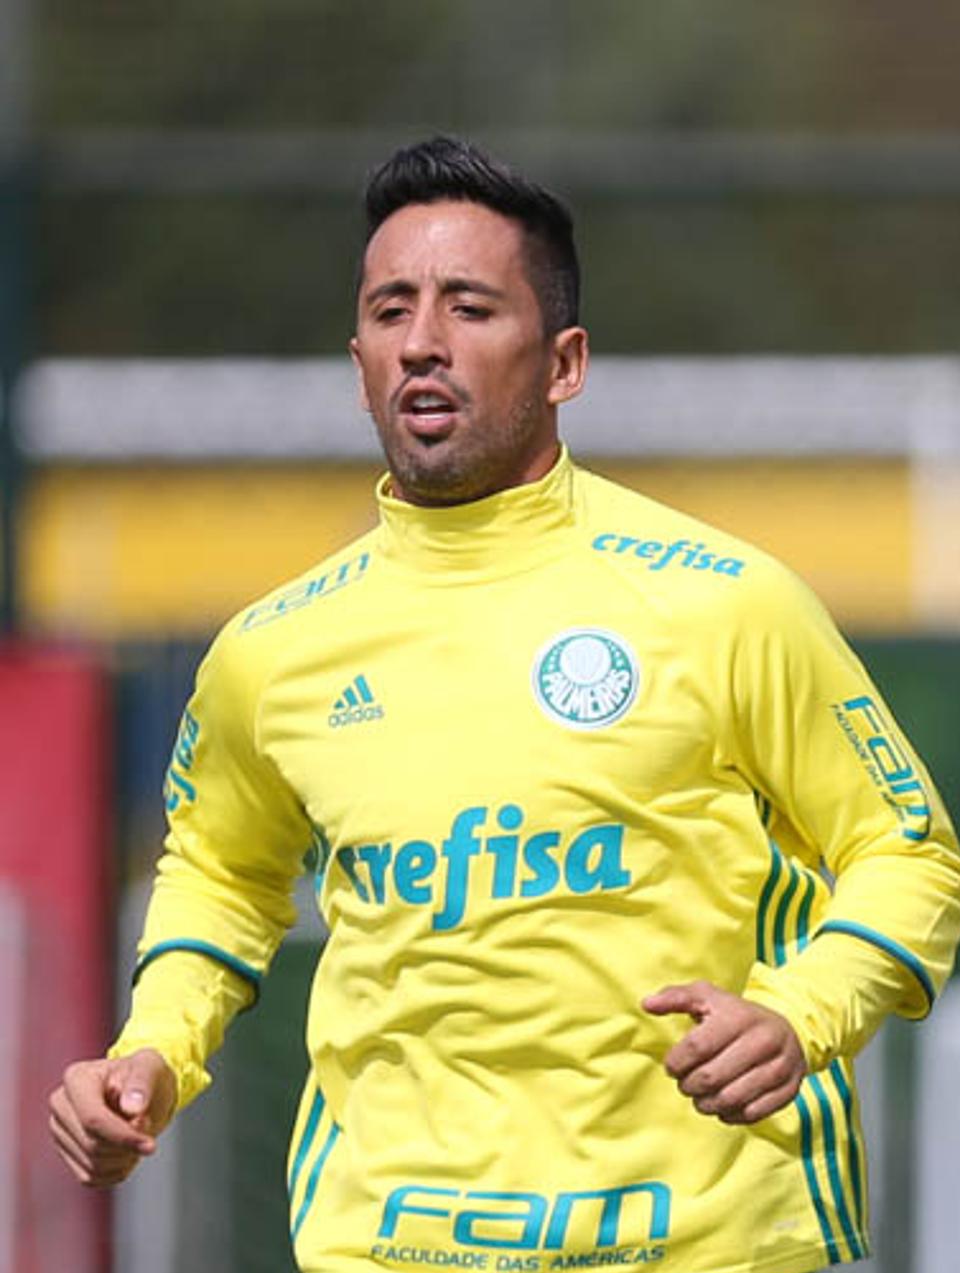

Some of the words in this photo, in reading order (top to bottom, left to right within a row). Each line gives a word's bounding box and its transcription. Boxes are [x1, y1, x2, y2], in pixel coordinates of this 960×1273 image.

[592, 533, 745, 577] crefisa
[541, 668, 632, 720] PALMEIRAS
[328, 702, 385, 728] adidas
[370, 1243, 489, 1270] FACULDADE
[496, 1254, 540, 1273] DAS
